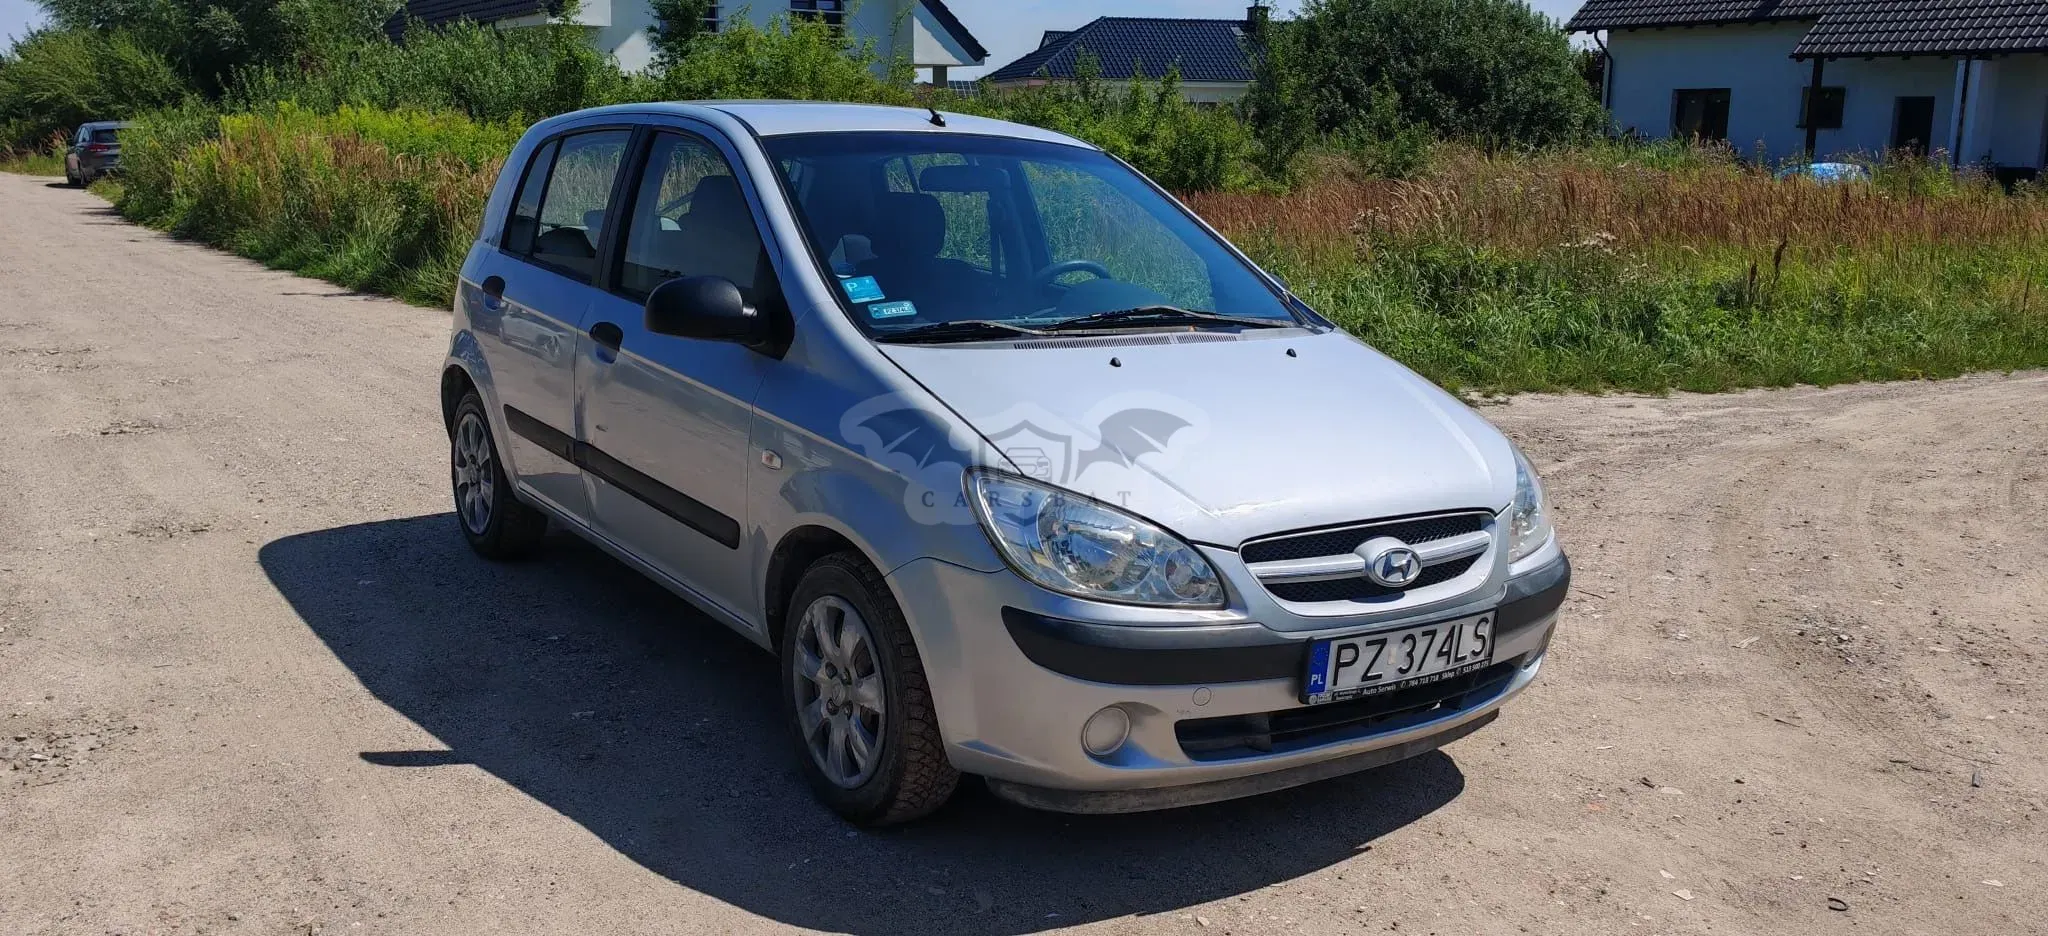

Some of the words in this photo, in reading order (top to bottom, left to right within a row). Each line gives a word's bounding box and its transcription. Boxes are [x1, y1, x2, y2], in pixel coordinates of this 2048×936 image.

[1332, 638, 1388, 686] PZ
[1397, 617, 1490, 675] 374LS
[1310, 674, 1324, 686] PL
[1363, 687, 1377, 696] Auto
